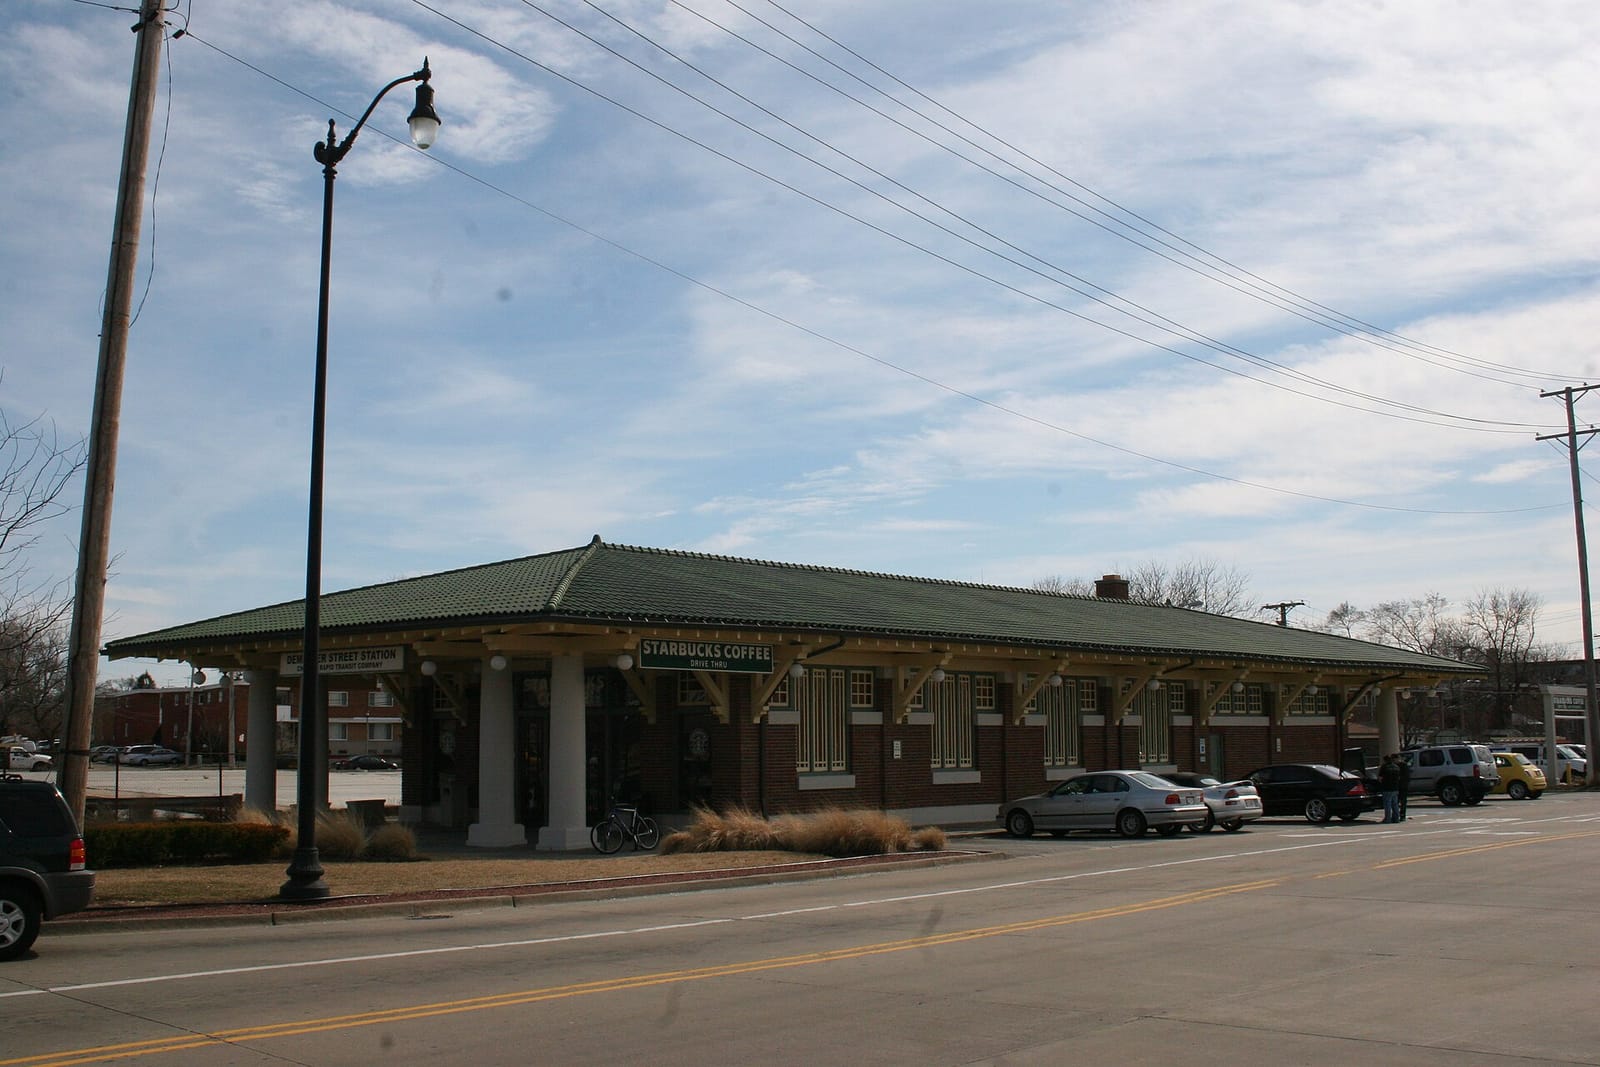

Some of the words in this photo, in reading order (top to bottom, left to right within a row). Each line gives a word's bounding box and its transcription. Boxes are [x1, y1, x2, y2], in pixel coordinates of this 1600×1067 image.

[643, 640, 721, 657] STARBUCKS
[724, 645, 770, 660] COFFEE
[287, 653, 327, 664] DEMER
[328, 651, 358, 662] STREET
[361, 649, 396, 661] STATION
[336, 662, 356, 670] TRANSIT
[358, 661, 383, 669] COMPANY
[690, 660, 709, 668] DRIVE
[711, 661, 728, 669] THRU
